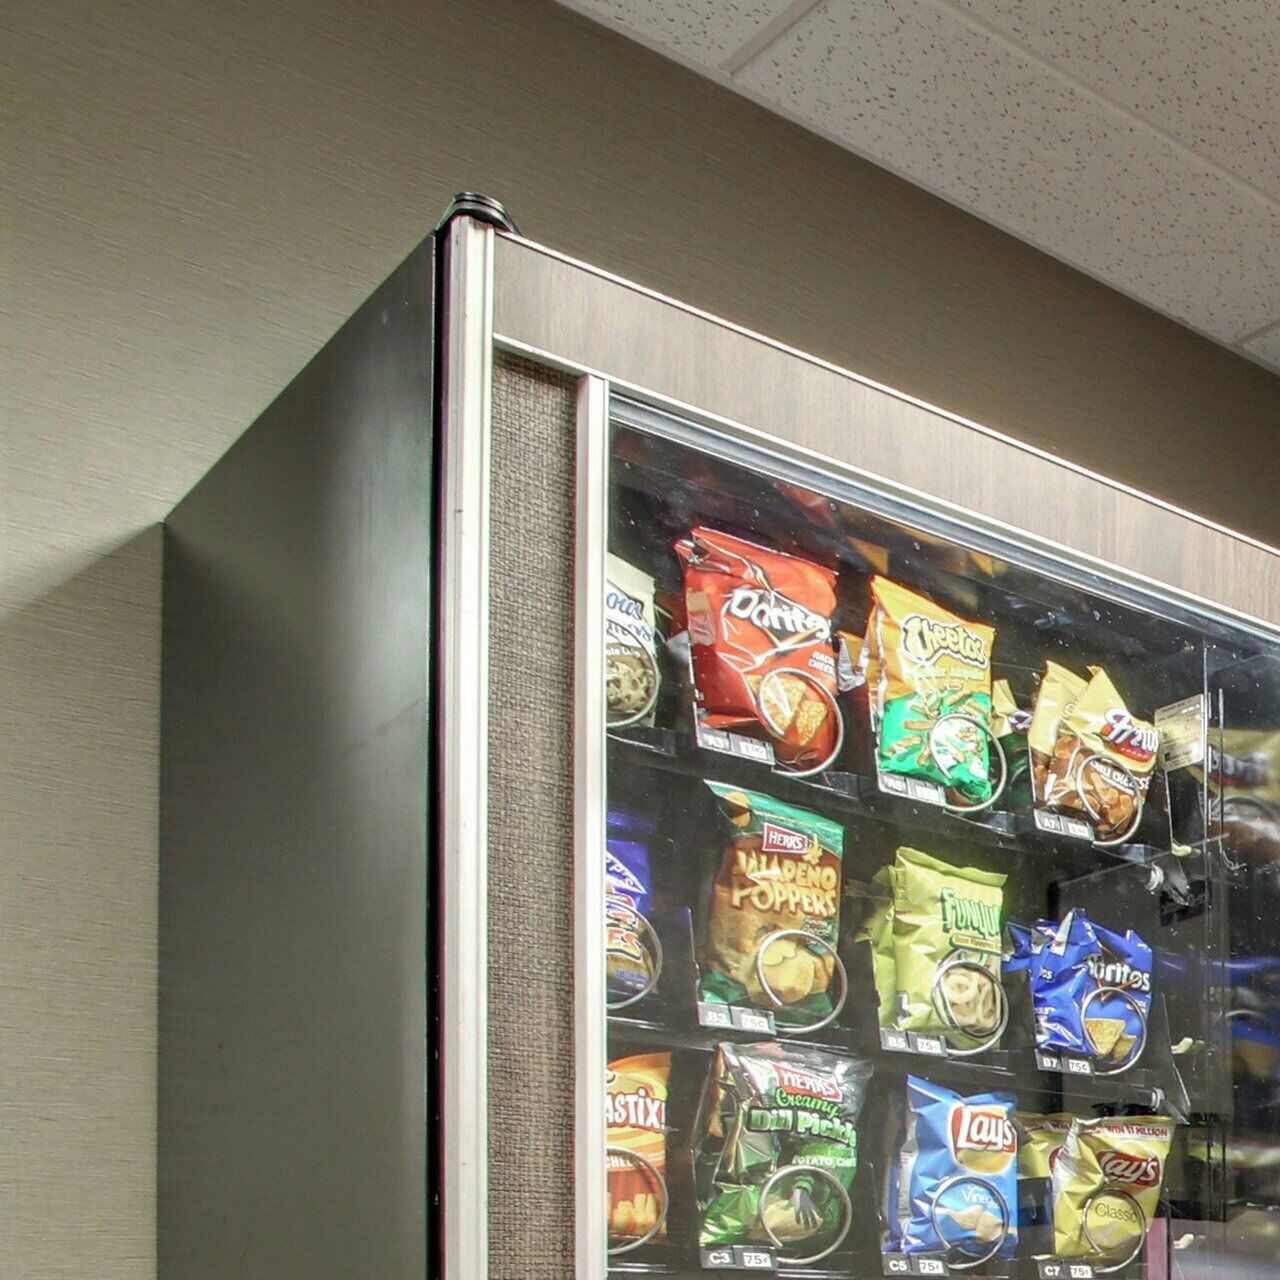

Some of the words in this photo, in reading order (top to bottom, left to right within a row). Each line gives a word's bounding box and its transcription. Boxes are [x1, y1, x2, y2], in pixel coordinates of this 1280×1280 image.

[730, 588, 831, 640] Doritos
[903, 615, 985, 664] Cheetos
[1113, 768, 1151, 791] CHESE
[1043, 818, 1056, 829] A7
[732, 875, 837, 916] POPPERS
[707, 1012, 727, 1024] B3
[888, 1037, 906, 1048] B5
[1043, 1058, 1058, 1069] B7
[776, 1087, 840, 1119] Creamy
[750, 1108, 793, 1131] Dill
[1135, 1126, 1168, 1137] MILLION
[709, 1252, 730, 1264] C3
[888, 1260, 907, 1271] C5
[1045, 1266, 1060, 1277] C7
